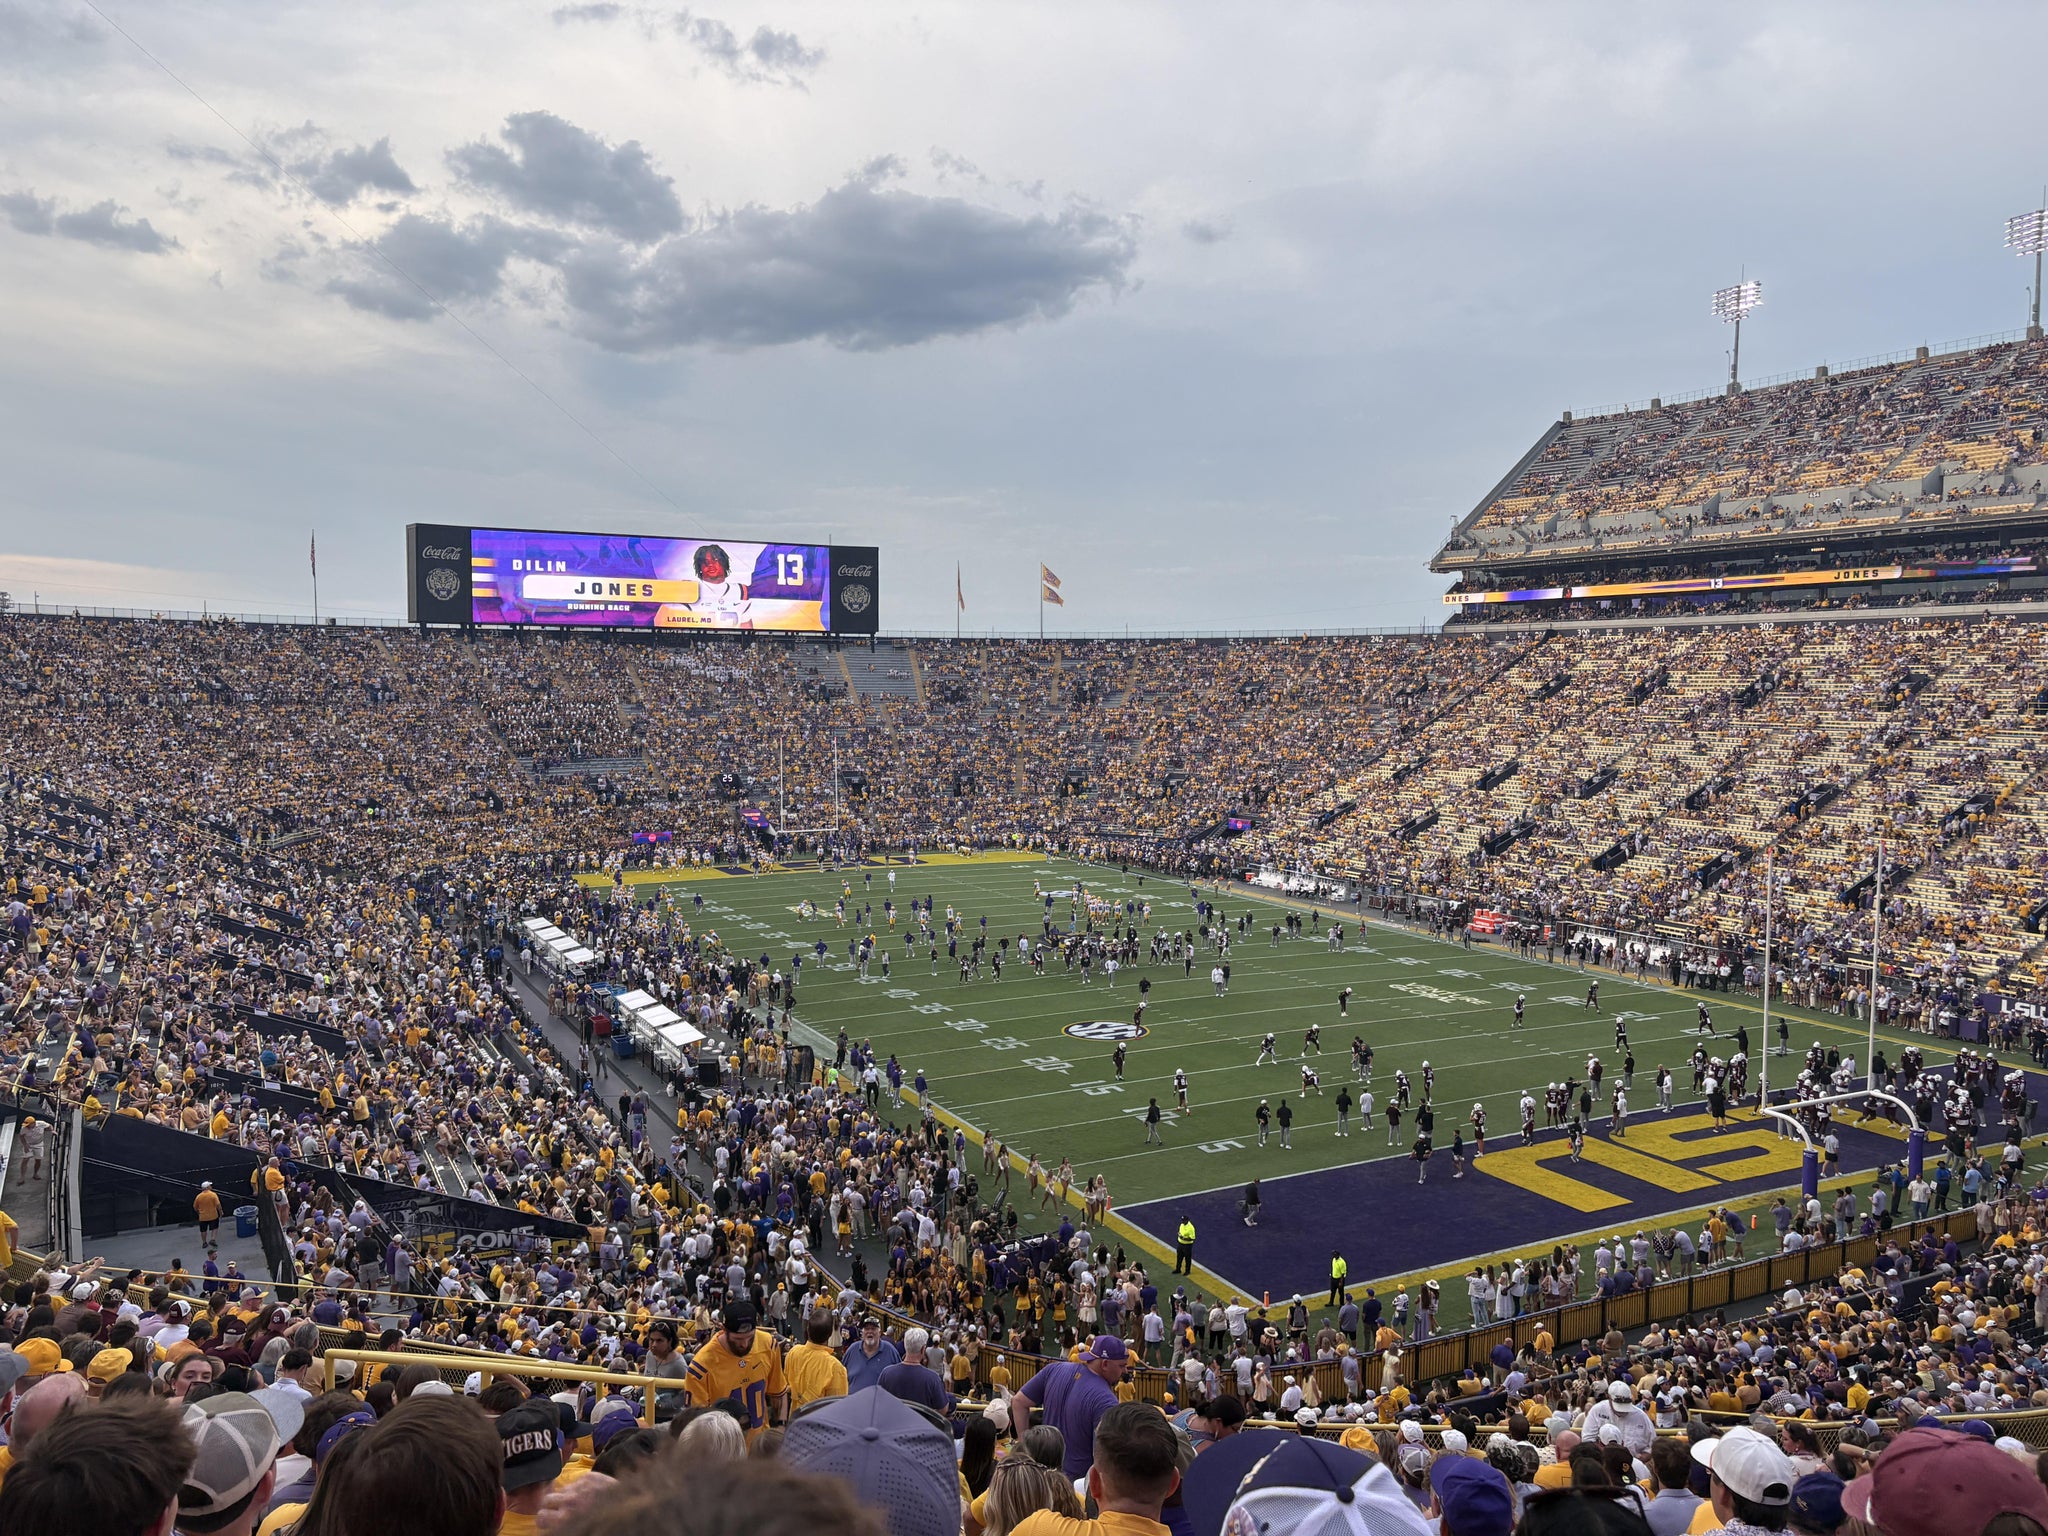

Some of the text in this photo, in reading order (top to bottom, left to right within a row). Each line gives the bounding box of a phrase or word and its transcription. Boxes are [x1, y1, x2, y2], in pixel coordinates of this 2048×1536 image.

[422, 545, 463, 560] Coca-Cola
[512, 559, 567, 572] DILIN
[777, 553, 804, 586] 13
[837, 564, 873, 577] Coca-Cola
[1834, 569, 1880, 580] JONES
[574, 581, 654, 597] JONES
[1709, 578, 1724, 589] 13
[567, 603, 630, 612] RUNNING BACK
[667, 616, 699, 624] LAUREL,
[1758, 622, 1775, 631] 302
[1370, 635, 1384, 643] 242
[2001, 999, 2047, 1019] LSU
[979, 1036, 1031, 1051] 25
[1021, 1055, 1075, 1072] 20
[1069, 1080, 1126, 1096] 15
[1197, 1139, 1247, 1154] 5
